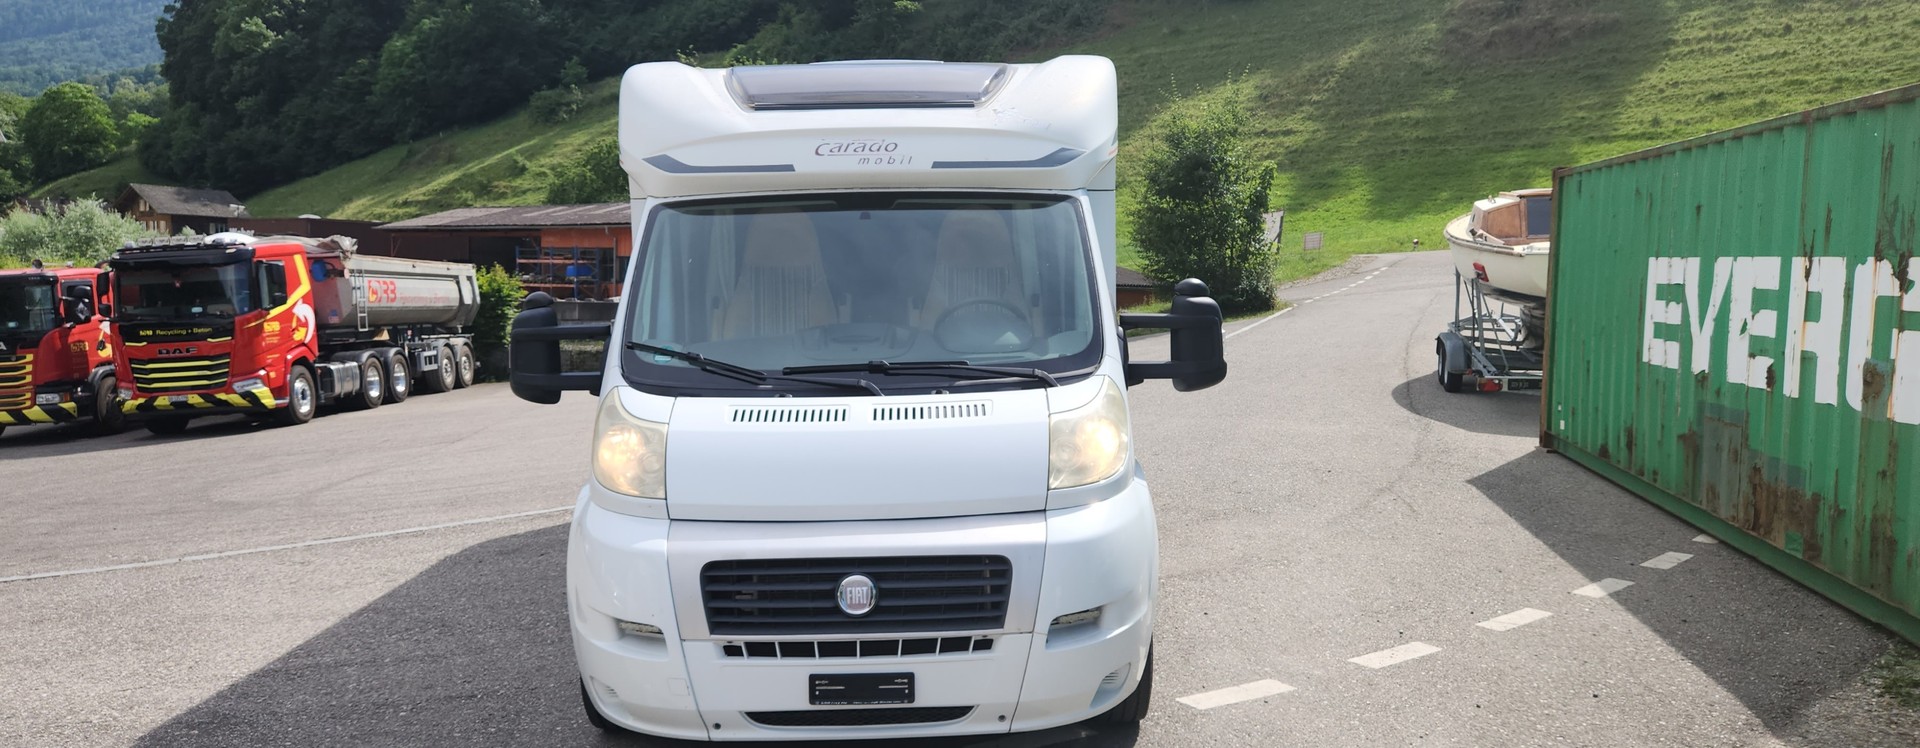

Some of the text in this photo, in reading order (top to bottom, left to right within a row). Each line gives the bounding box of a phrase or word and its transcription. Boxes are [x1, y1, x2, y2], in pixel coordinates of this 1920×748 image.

[858, 156, 912, 165] mobil
[156, 328, 187, 336] Recycling
[158, 347, 198, 356] DAF
[846, 586, 868, 605] FIAT
